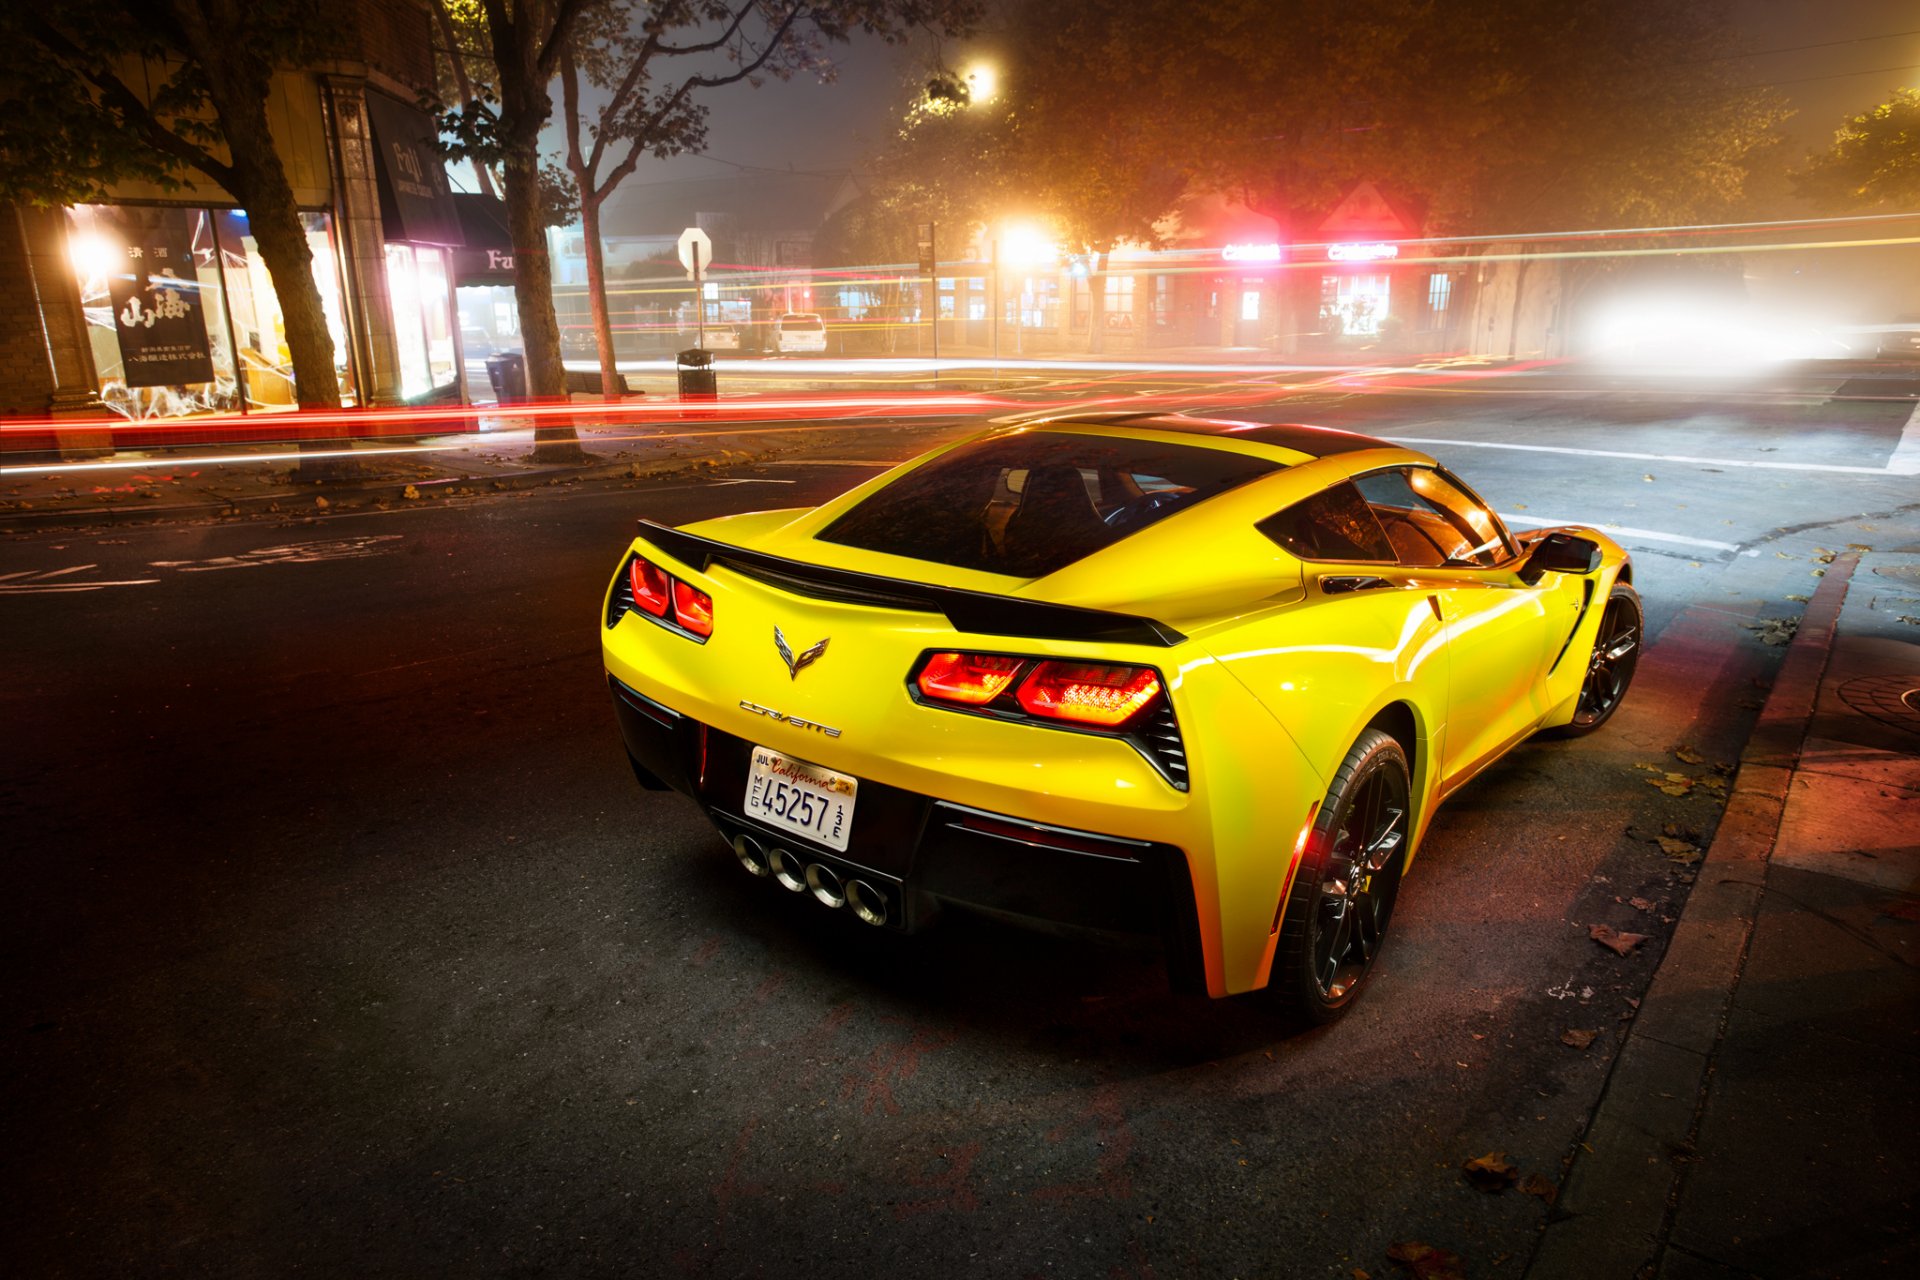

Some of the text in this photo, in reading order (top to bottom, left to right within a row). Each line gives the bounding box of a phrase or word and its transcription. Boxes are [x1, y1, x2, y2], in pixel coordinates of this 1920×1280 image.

[739, 700, 842, 737] CORVETTE
[756, 754, 769, 766] JUL
[771, 758, 836, 793] California
[762, 779, 829, 831] 45257
